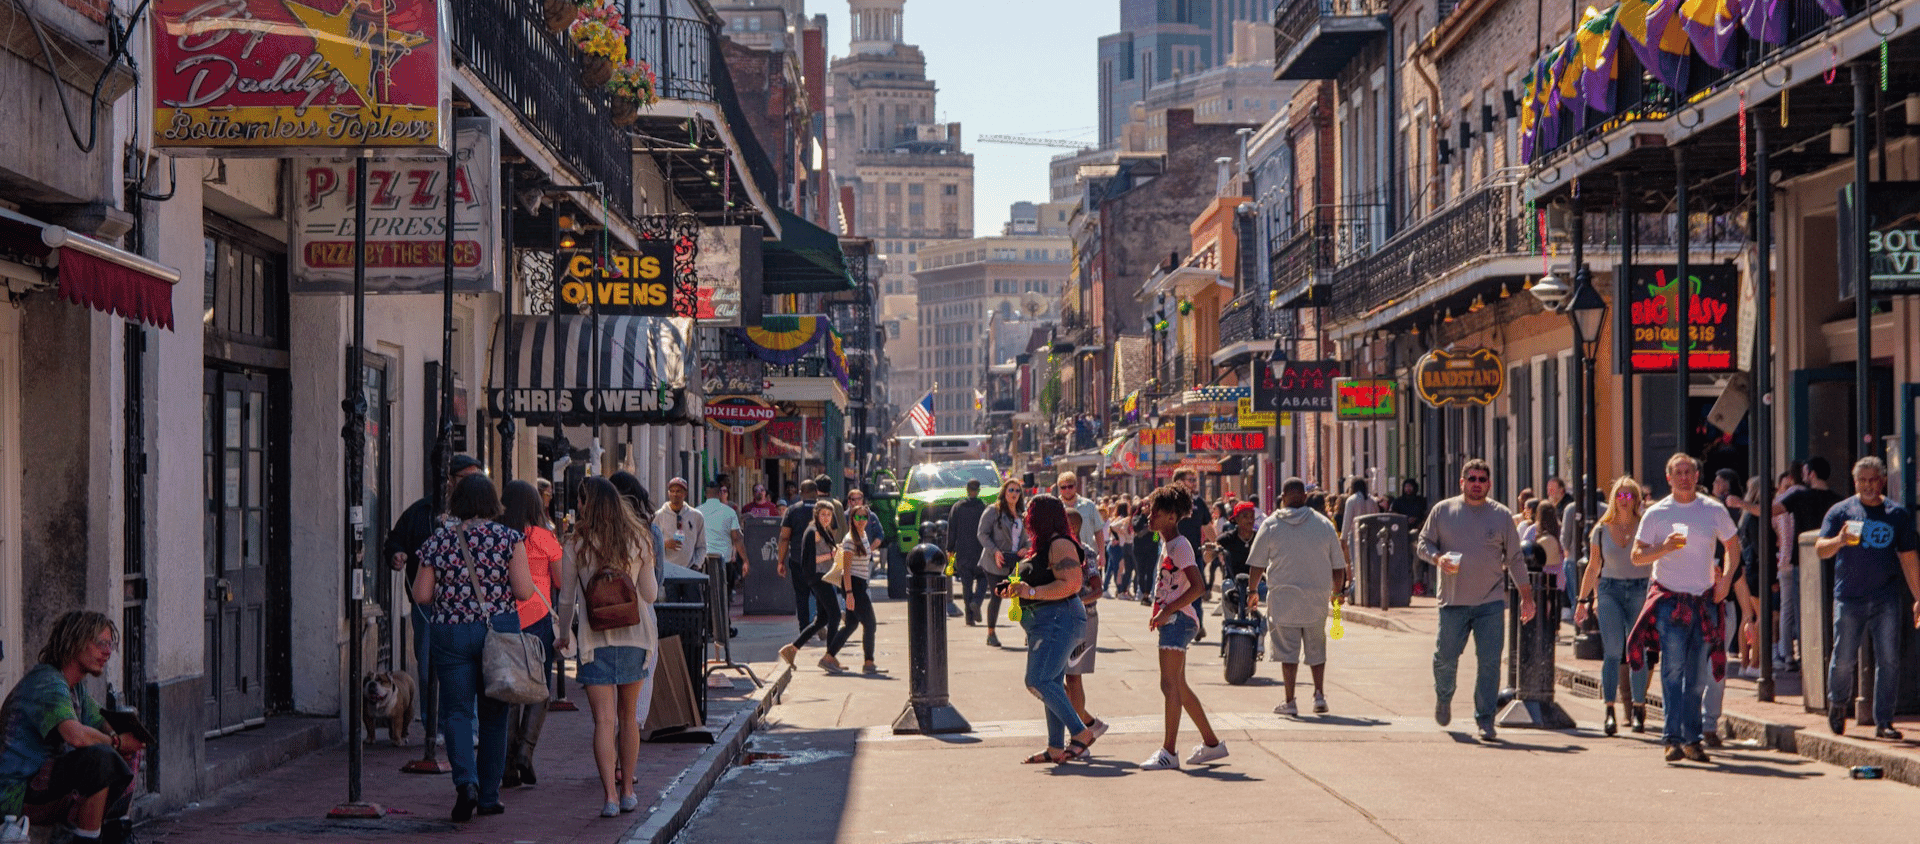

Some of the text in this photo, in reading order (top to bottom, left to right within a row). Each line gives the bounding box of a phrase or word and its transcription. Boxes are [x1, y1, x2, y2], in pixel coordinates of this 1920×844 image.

[177, 0, 270, 59] Big
[162, 52, 350, 117] Daddy's
[164, 107, 434, 145] Bottomless Topless
[364, 244, 385, 264] BY
[391, 244, 424, 264] THE
[427, 245, 476, 264] SLCE
[561, 281, 668, 306] OWENS
[1631, 293, 1728, 325] BIG ASY
[1262, 378, 1334, 390] SUTR
[1423, 369, 1500, 388] BANDSTAND
[583, 389, 676, 413] OWENS
[704, 406, 775, 419] DIXIELAND
